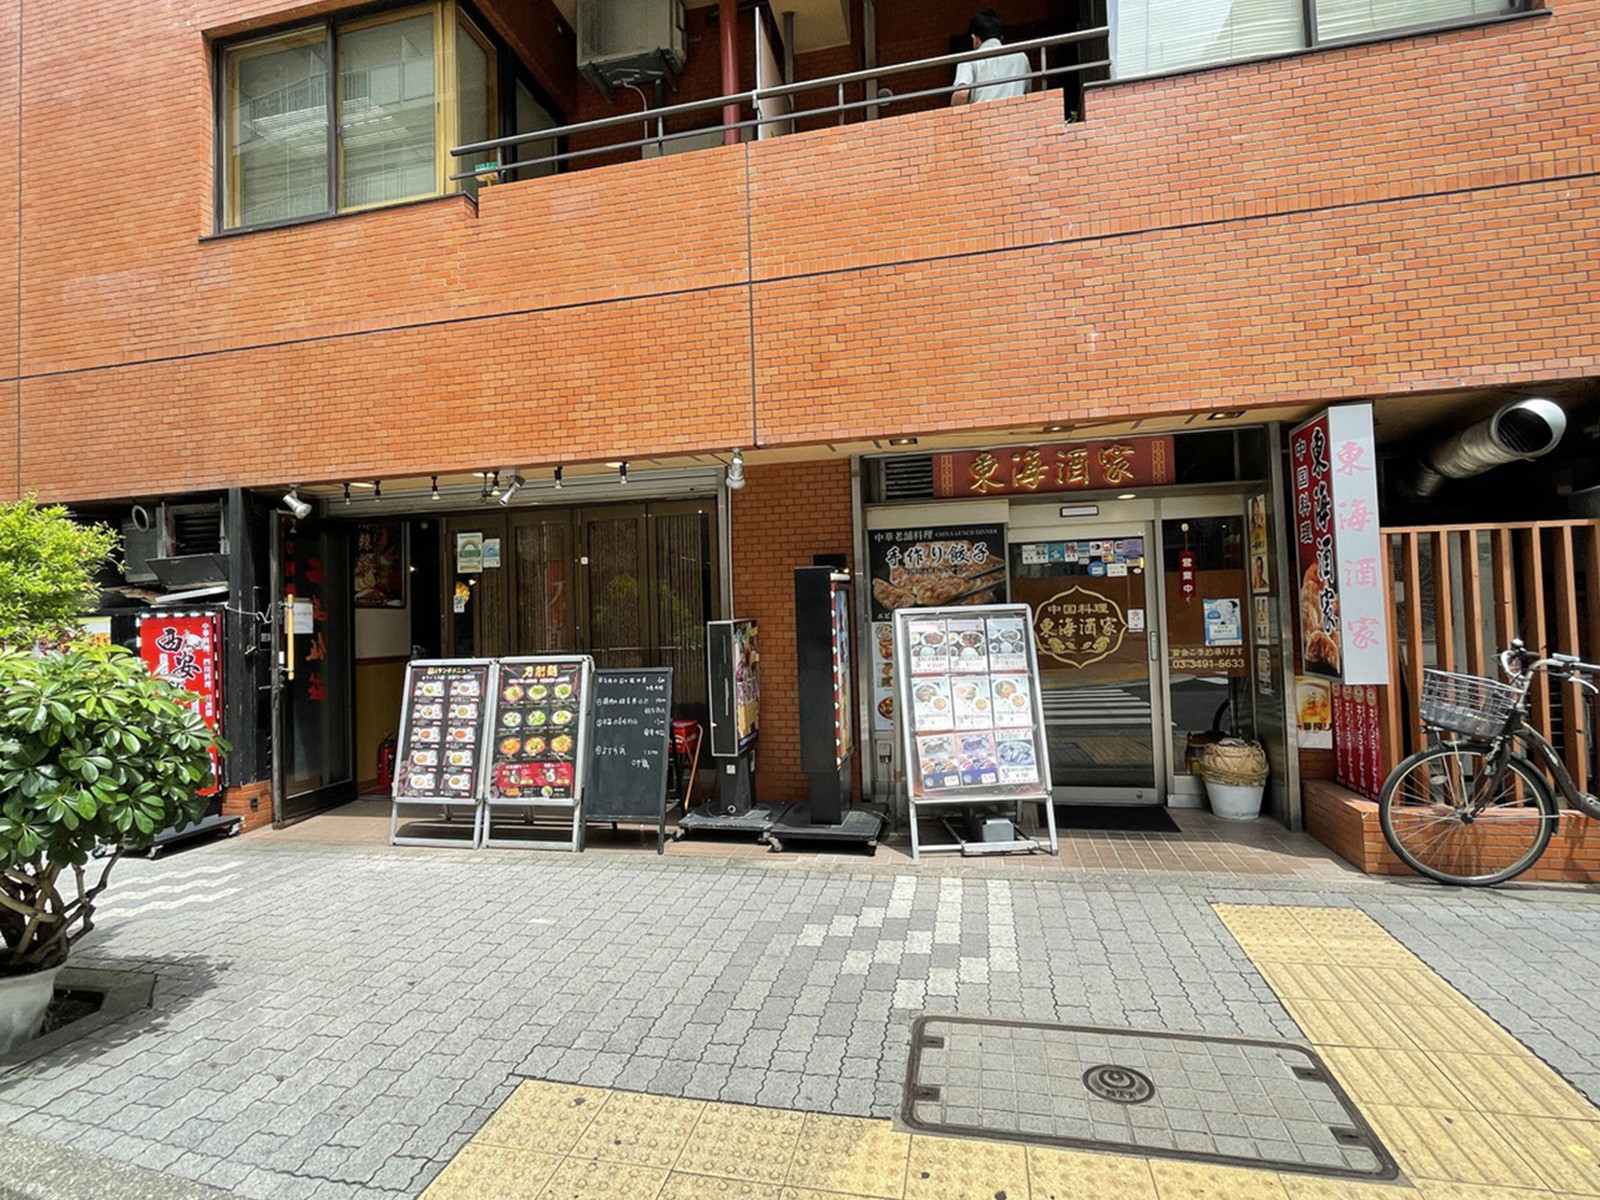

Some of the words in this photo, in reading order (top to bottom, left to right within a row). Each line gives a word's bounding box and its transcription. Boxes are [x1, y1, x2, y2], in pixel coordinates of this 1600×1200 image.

[969, 444, 1136, 493] 東海酒家
[1295, 437, 1312, 544] 中国料理
[1310, 426, 1338, 636] 東海酒家
[1336, 440, 1380, 649] 東海酒家
[885, 541, 990, 567] 手作り餃子
[1181, 557, 1194, 593] 営業中
[1039, 616, 1118, 637] 東海酒家
[1047, 603, 1109, 615] 中国料理
[1172, 658, 1245, 669] 03-3491-5633
